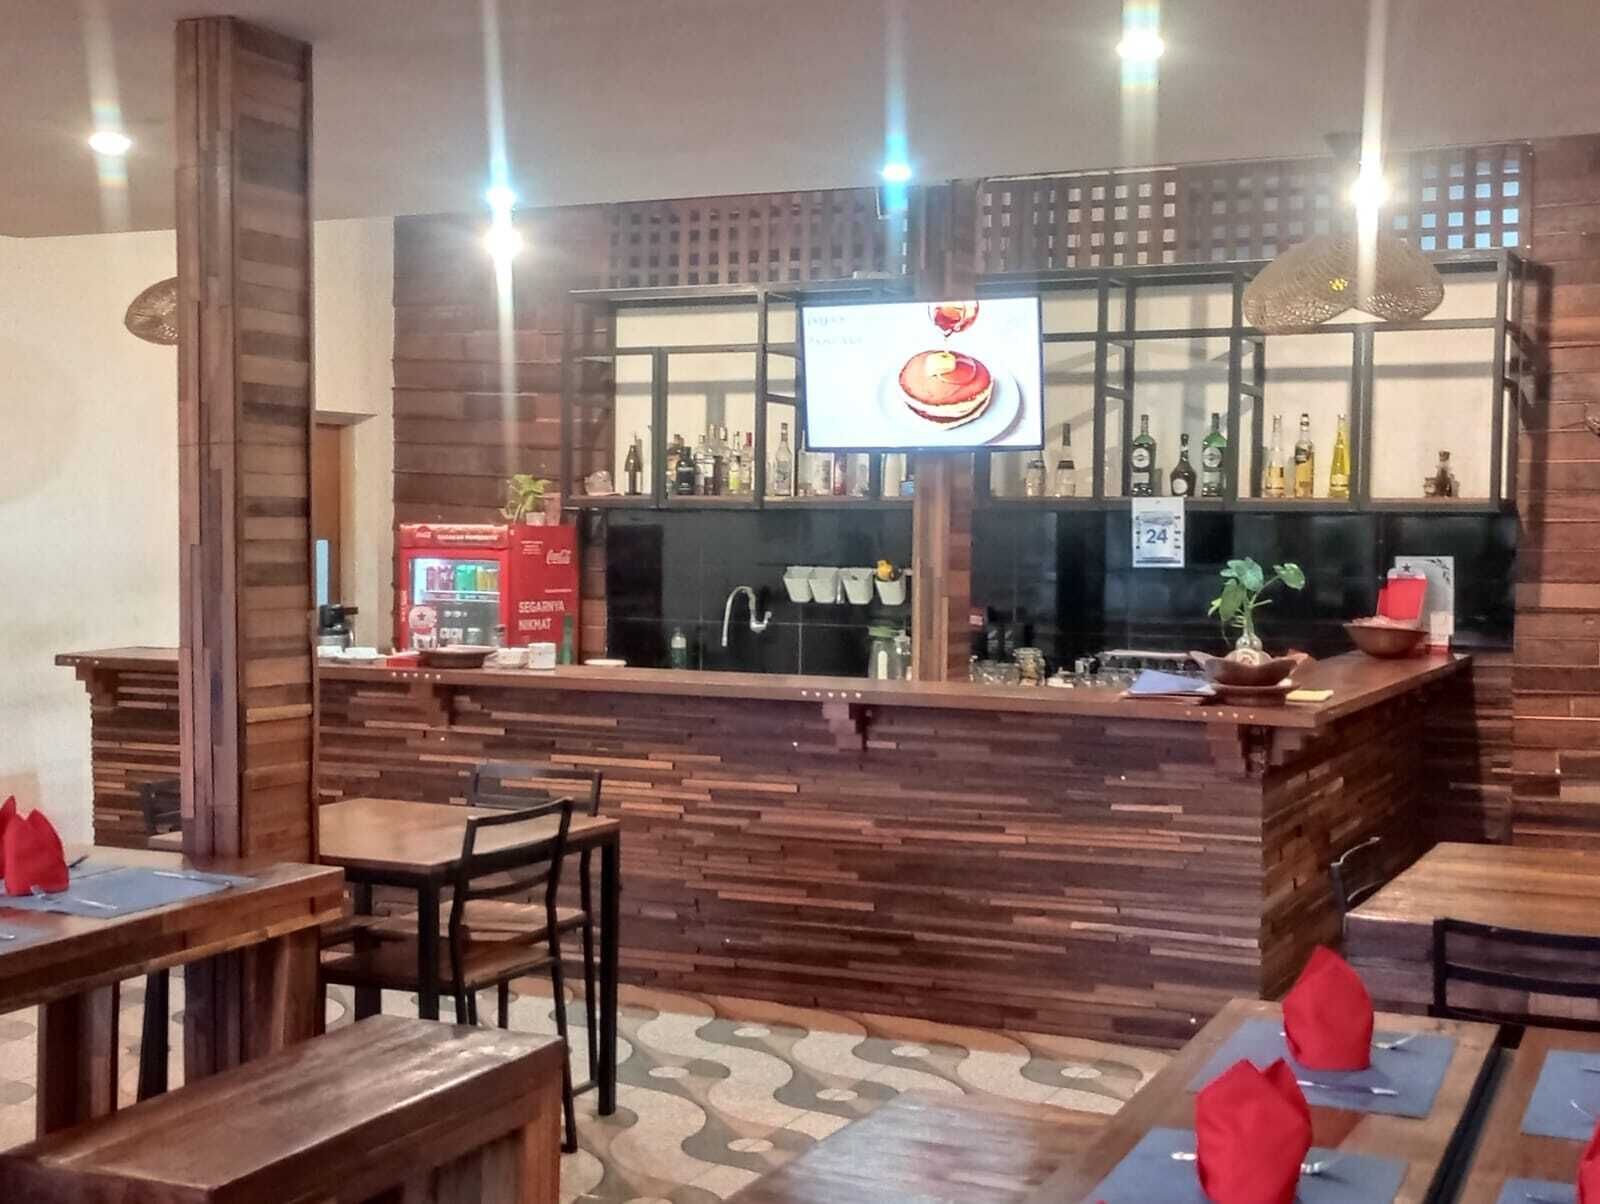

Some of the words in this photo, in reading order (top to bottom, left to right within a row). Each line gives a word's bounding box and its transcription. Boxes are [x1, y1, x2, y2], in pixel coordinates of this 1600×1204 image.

[1146, 529, 1168, 544] 24
[518, 600, 565, 613] SEGARNYA
[518, 618, 552, 632] NIKMAT
